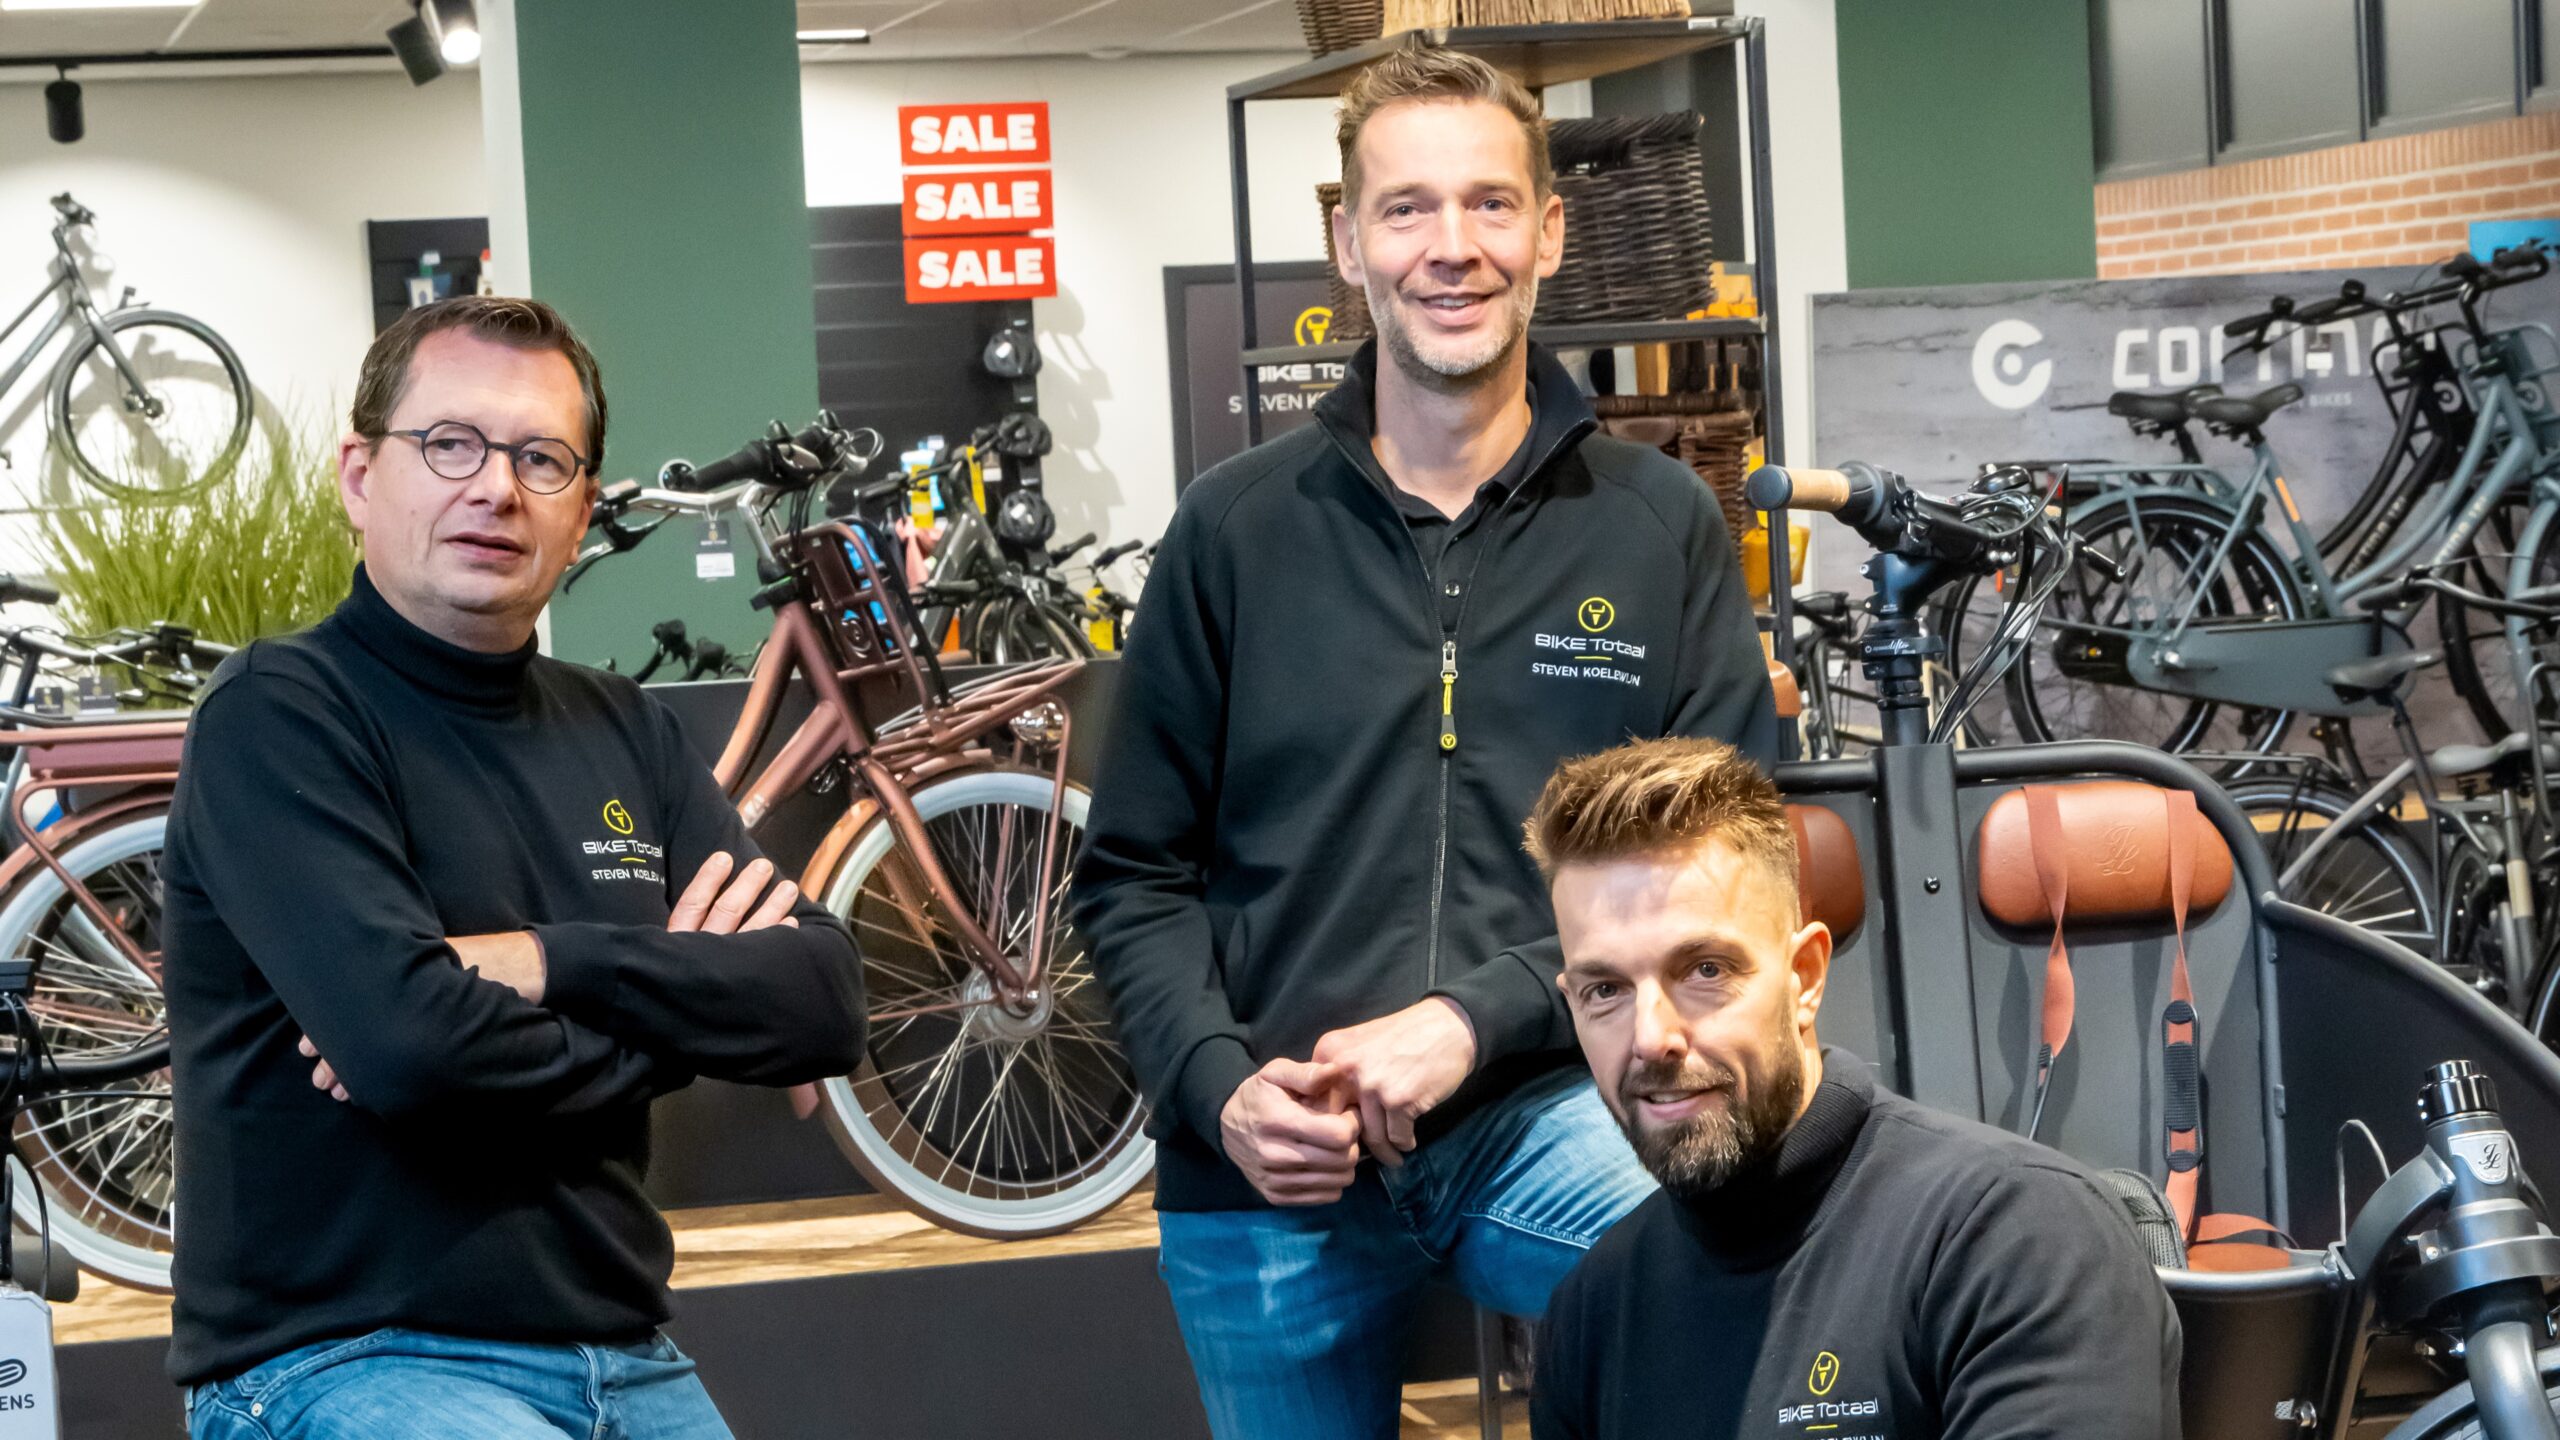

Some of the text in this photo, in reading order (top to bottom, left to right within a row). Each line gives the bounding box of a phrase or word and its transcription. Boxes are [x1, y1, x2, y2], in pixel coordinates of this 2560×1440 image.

[910, 113, 1038, 155] SALE
[914, 180, 1042, 222] SALE
[918, 247, 1045, 289] SALE
[1534, 633, 1646, 659] BIKE Totaal
[1531, 662, 1579, 678] STEVEN
[582, 840, 627, 854] BIKE
[591, 868, 631, 881] STEVEN
[1778, 1396, 1879, 1424] BIKE Totaal
